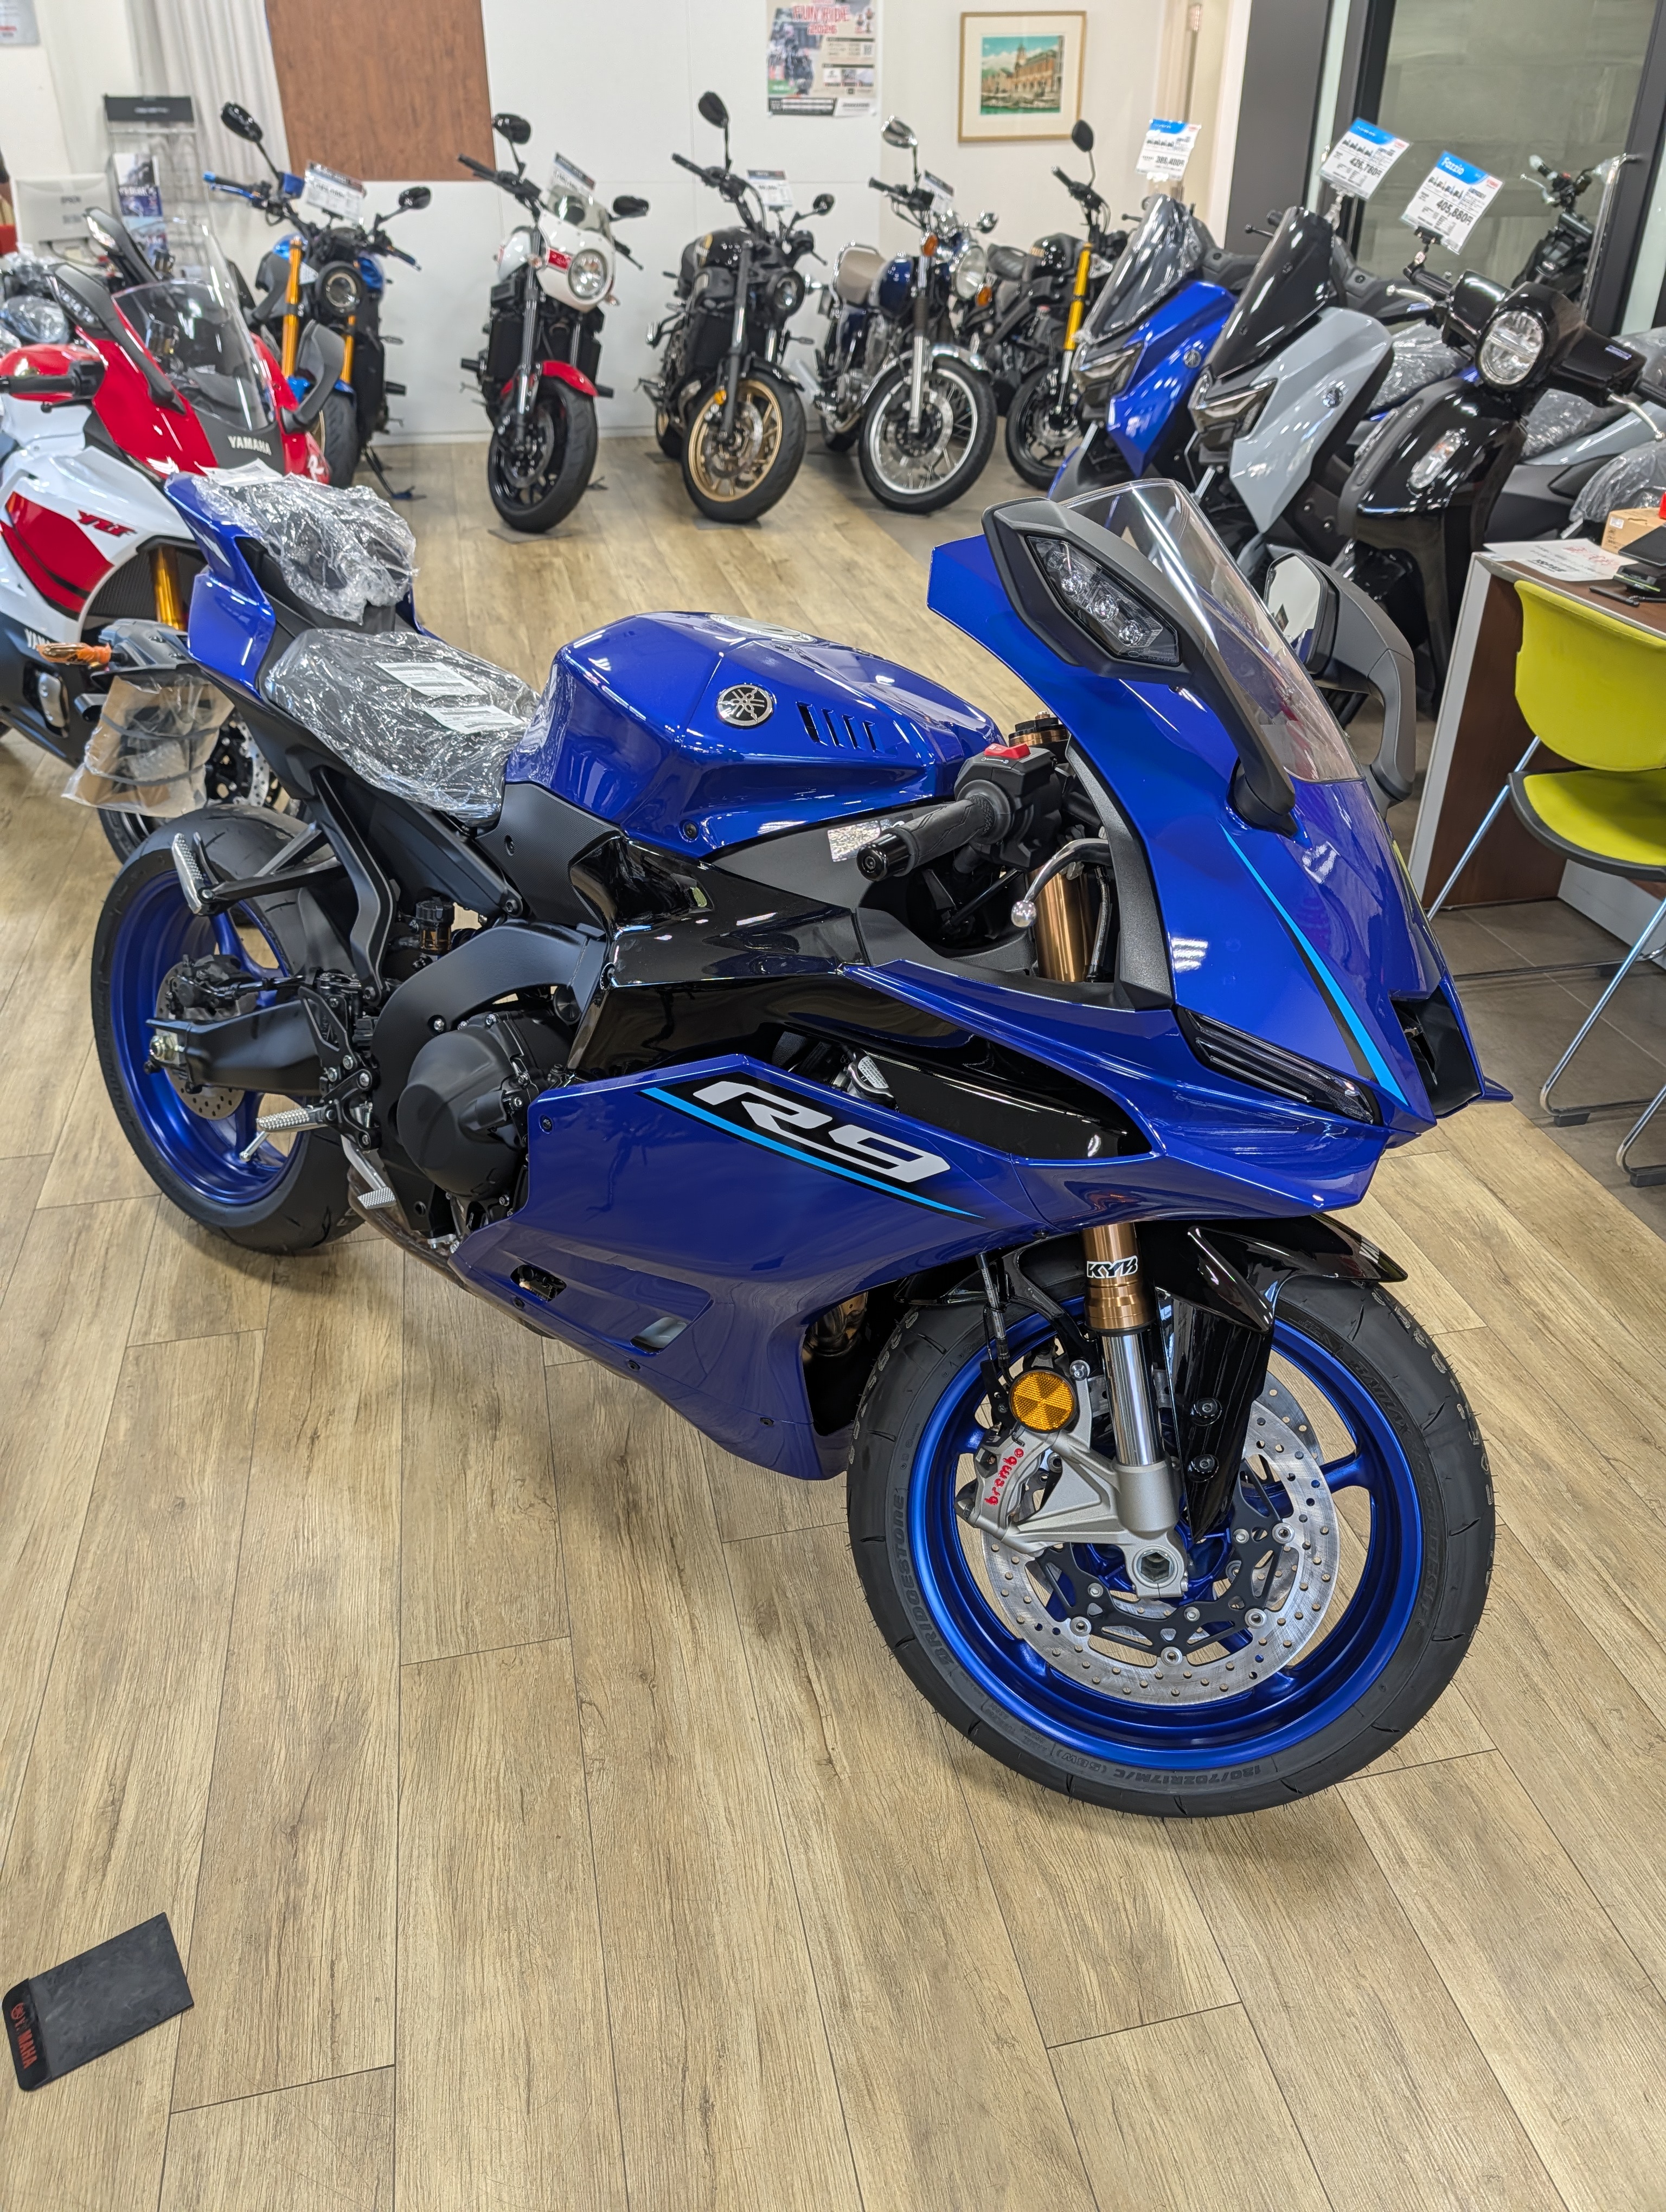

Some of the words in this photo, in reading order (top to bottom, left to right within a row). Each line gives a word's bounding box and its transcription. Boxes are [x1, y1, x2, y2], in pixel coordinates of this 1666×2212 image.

[228, 435, 272, 456] YAMAHA
[693, 1081, 951, 1182] R9
[1087, 1255, 1138, 1278] KYB
[984, 1448, 1024, 1506] brembo
[893, 1493, 956, 1667] BRIDGESTONE
[14, 2015, 37, 2070] YMAHA
